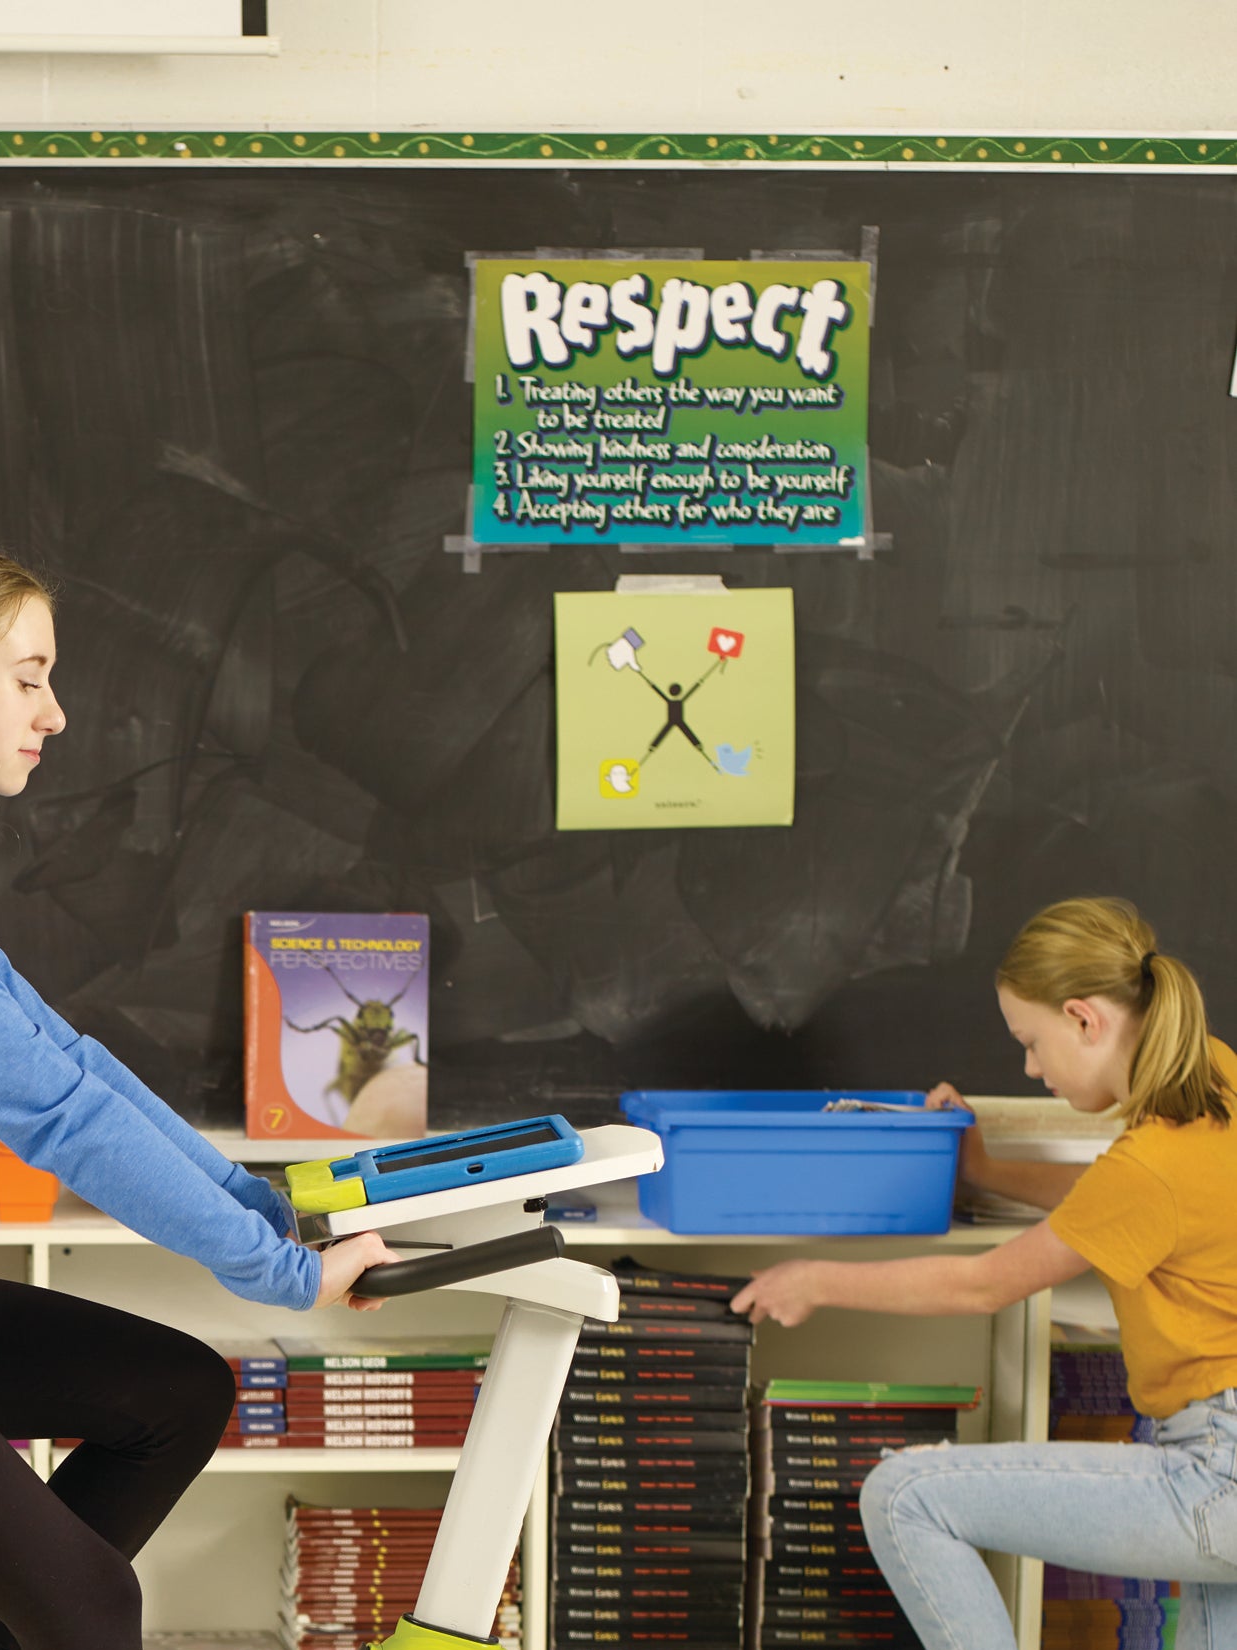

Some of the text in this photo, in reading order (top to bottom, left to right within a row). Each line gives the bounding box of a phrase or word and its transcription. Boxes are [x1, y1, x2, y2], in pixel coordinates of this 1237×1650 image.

[501, 272, 848, 376] Respect
[518, 376, 596, 410] Treating
[603, 378, 662, 403] others
[669, 378, 701, 401] the
[704, 386, 745, 408] way
[749, 386, 784, 408] you
[788, 384, 839, 403] want
[537, 403, 666, 429] to be treated
[516, 431, 594, 466] Showing
[599, 433, 671, 460] kindness
[676, 434, 711, 459] and
[715, 434, 831, 461] consideration
[516, 463, 569, 497] Liking
[573, 463, 648, 494] yourself
[650, 465, 714, 498] enough
[719, 469, 741, 489] to
[746, 463, 771, 490] be
[774, 465, 850, 495] yourself
[515, 489, 606, 528] Accepting
[611, 495, 671, 522] others
[676, 494, 707, 524] for
[711, 495, 752, 520] who
[756, 495, 799, 527] they
[801, 504, 836, 521] are
[270, 937, 422, 952] SCIENCE & TECHNOLOGY
[270, 951, 422, 971] PERSPECTIVES
[268, 1109, 284, 1129] 7
[323, 1356, 361, 1369] NELSON
[324, 1373, 363, 1386] NELSON
[323, 1388, 362, 1401] NELSON
[324, 1403, 363, 1416] NELSON
[325, 1419, 364, 1432] NELSON
[324, 1434, 363, 1447] NELSON
